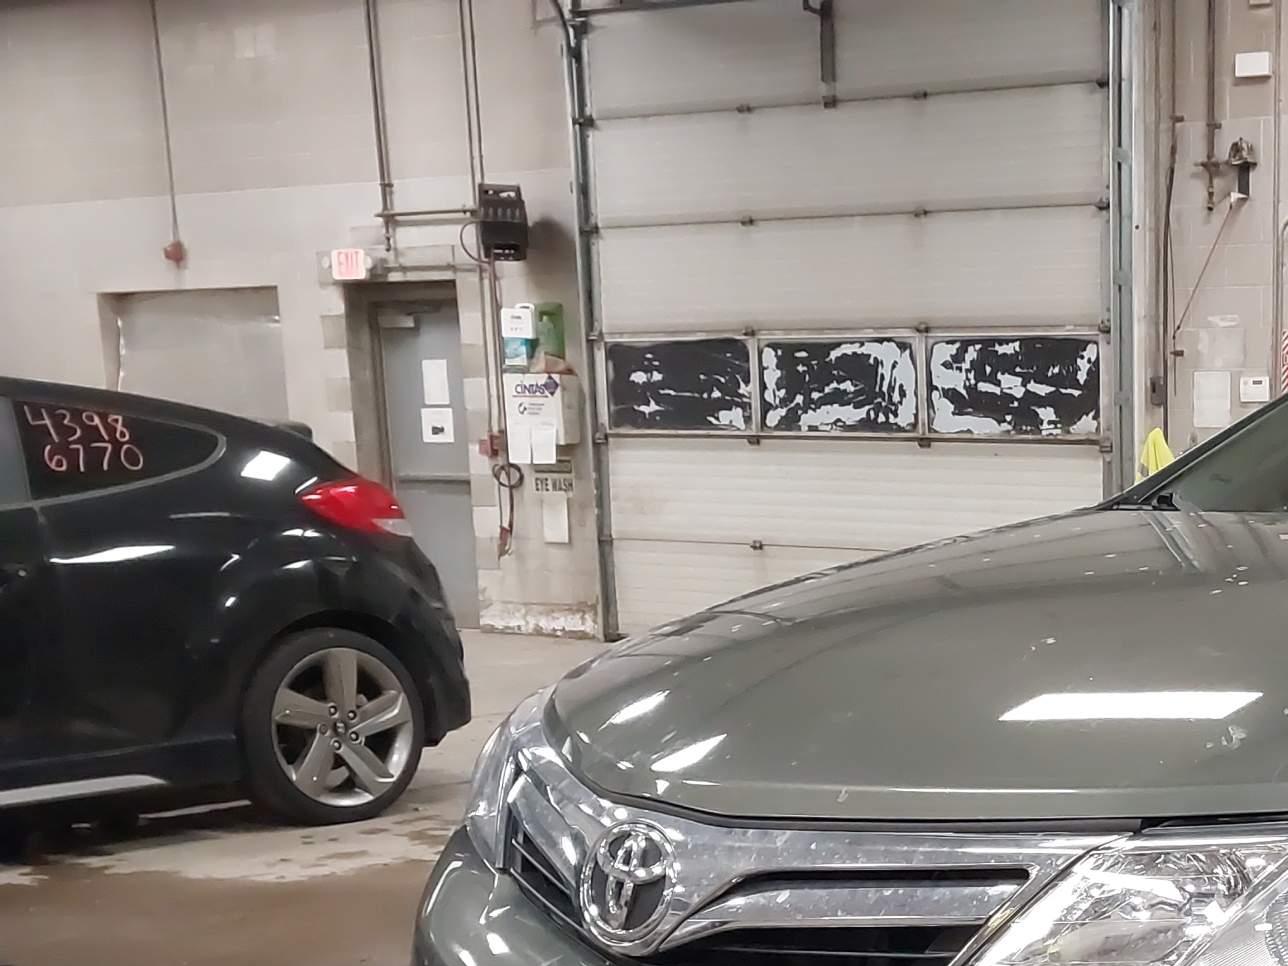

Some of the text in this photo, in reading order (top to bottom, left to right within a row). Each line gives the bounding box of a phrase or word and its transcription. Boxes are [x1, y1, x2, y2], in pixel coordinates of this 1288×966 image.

[514, 382, 546, 395] CINTAS
[24, 405, 130, 442] 4398
[44, 443, 144, 472] 6770
[535, 477, 574, 492] EYE WASH
